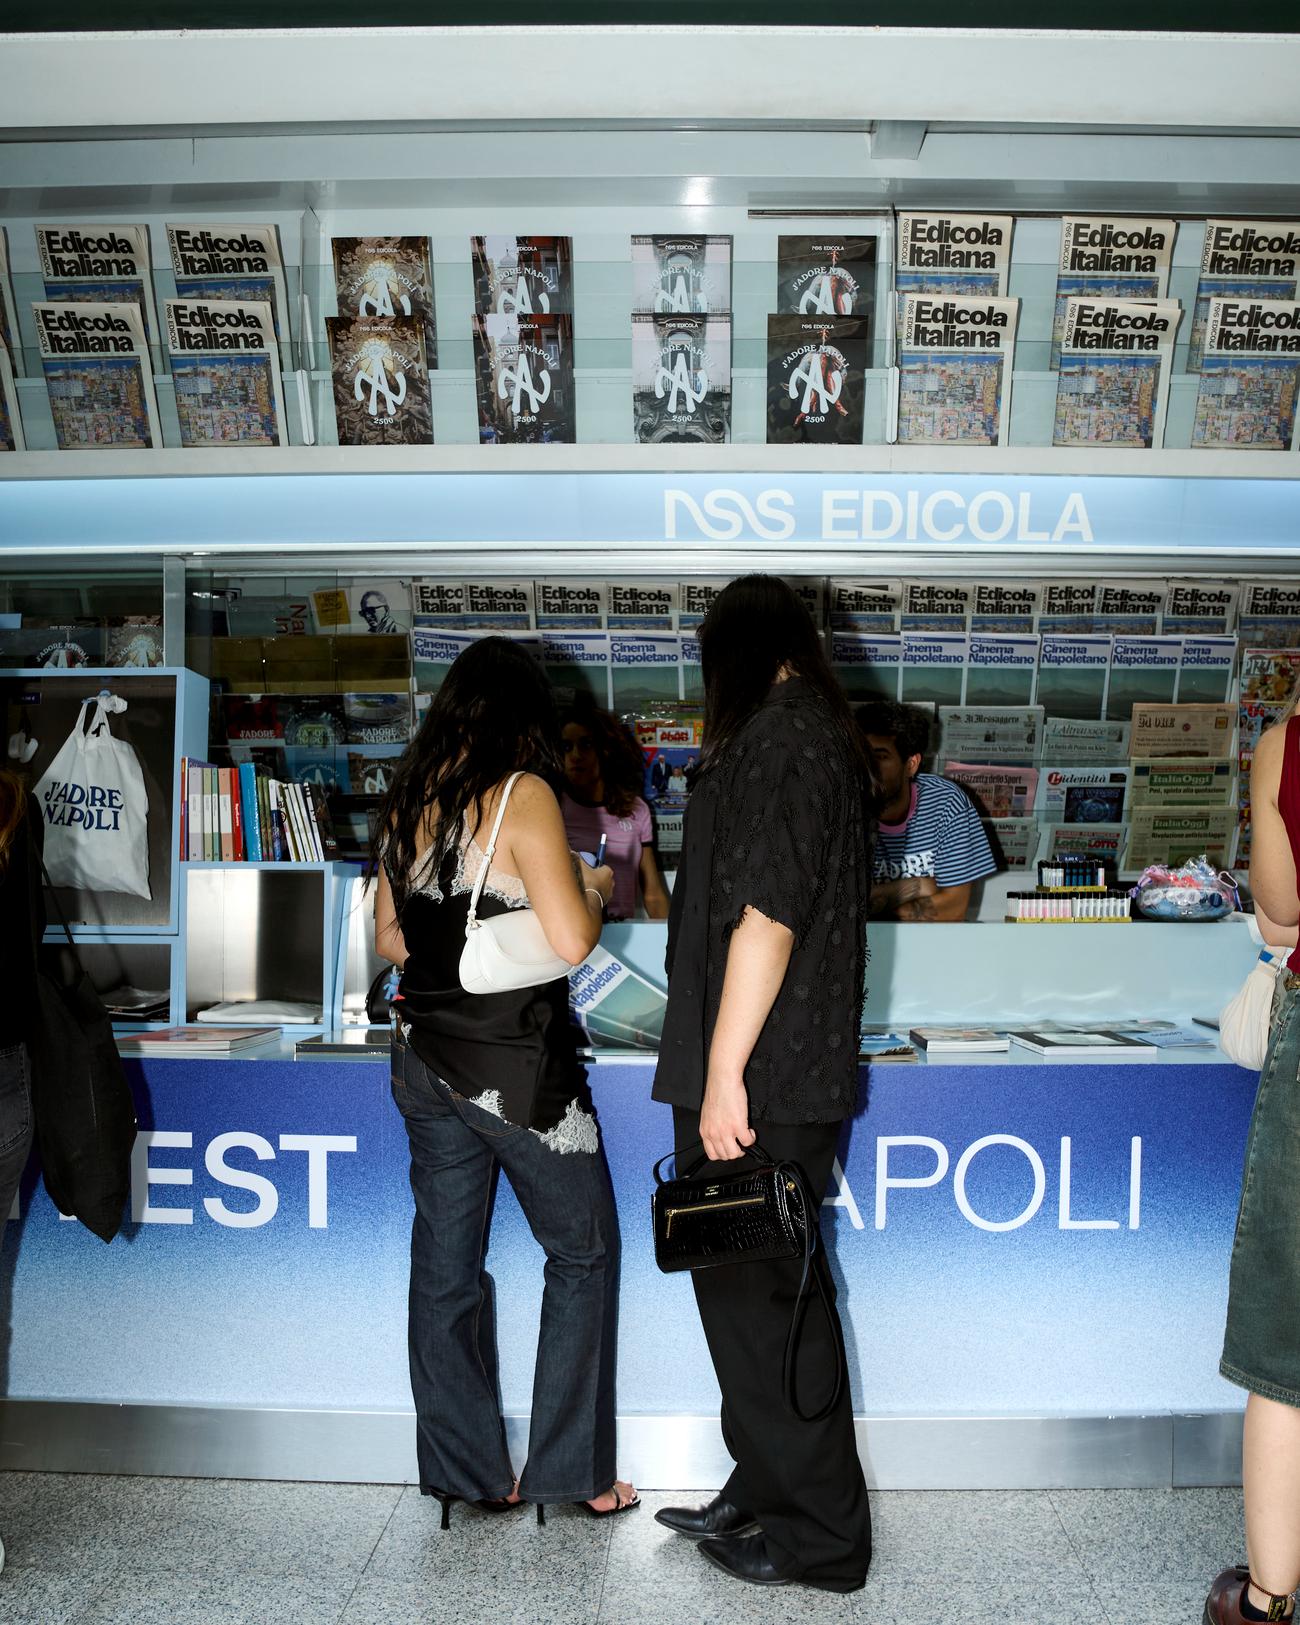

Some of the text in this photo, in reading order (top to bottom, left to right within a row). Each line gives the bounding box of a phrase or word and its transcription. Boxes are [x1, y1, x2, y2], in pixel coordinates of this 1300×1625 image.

[910, 219, 1002, 246] Edicola
[1072, 223, 1166, 250] Edicola
[45, 230, 134, 254] Edicola
[175, 230, 266, 253] Edicola
[1212, 227, 1300, 254] Edicola
[909, 244, 996, 268] Italiana
[1070, 248, 1156, 272] Italiana
[50, 254, 137, 276] Italiana
[180, 253, 268, 275] Italiana
[1209, 252, 1296, 276] Italiana
[391, 269, 416, 293] APOLI
[524, 267, 556, 291] NAPOLI
[829, 267, 860, 291] NAPOLI
[41, 310, 131, 332] Edicola
[173, 304, 262, 328] Edicola
[915, 301, 1008, 327] Edicola
[1076, 305, 1169, 332] Edicola
[47, 332, 134, 354] Italiana
[177, 328, 264, 350] Italiana
[914, 324, 1000, 348] Italiana
[1072, 328, 1158, 350] Italiana
[1216, 328, 1300, 352] Italiana
[387, 348, 412, 370] APOLI
[525, 344, 557, 368] NAPOLI
[819, 345, 850, 368] NAPOLI
[804, 415, 826, 423] 2500
[822, 490, 1094, 542] EDICOLA
[420, 586, 462, 599] Edico
[468, 586, 527, 600] Edicola
[542, 586, 600, 600] Edicola
[612, 587, 671, 602] Edicola
[686, 586, 720, 599] Edic
[837, 588, 896, 604] Edicola
[908, 586, 968, 600] Edicola
[978, 586, 1036, 601] Edicola
[1048, 586, 1096, 600] Edicol
[1103, 588, 1162, 604] Edicola
[1174, 588, 1231, 604] Edicola
[470, 600, 526, 612] Italiana
[543, 600, 598, 614] Italiana
[613, 601, 669, 614] Italiana
[837, 601, 892, 612] Italiana
[908, 600, 964, 614] Italiana
[976, 601, 1032, 614] Italiana
[1047, 601, 1094, 614] Italian
[1100, 602, 1155, 614] Italiana
[1172, 602, 1225, 616] Italiana
[414, 638, 459, 651] Cinema
[611, 643, 656, 652] Cinema
[833, 643, 878, 653] Cinema
[970, 644, 1014, 654] Cinema
[1042, 644, 1087, 654] Cinema
[1114, 645, 1158, 655] Cinema
[414, 648, 460, 660] Napole
[612, 653, 678, 664] Napoletano
[968, 654, 1034, 665] Napoletano
[1042, 654, 1107, 665] Napoletano
[1112, 656, 1178, 666] Napoletano
[1182, 656, 1231, 666] poletano
[44, 804, 120, 830] NAPOLI
[1154, 819, 1208, 830] ItaliaOggi
[820, 1134, 1142, 1232] APOLI
